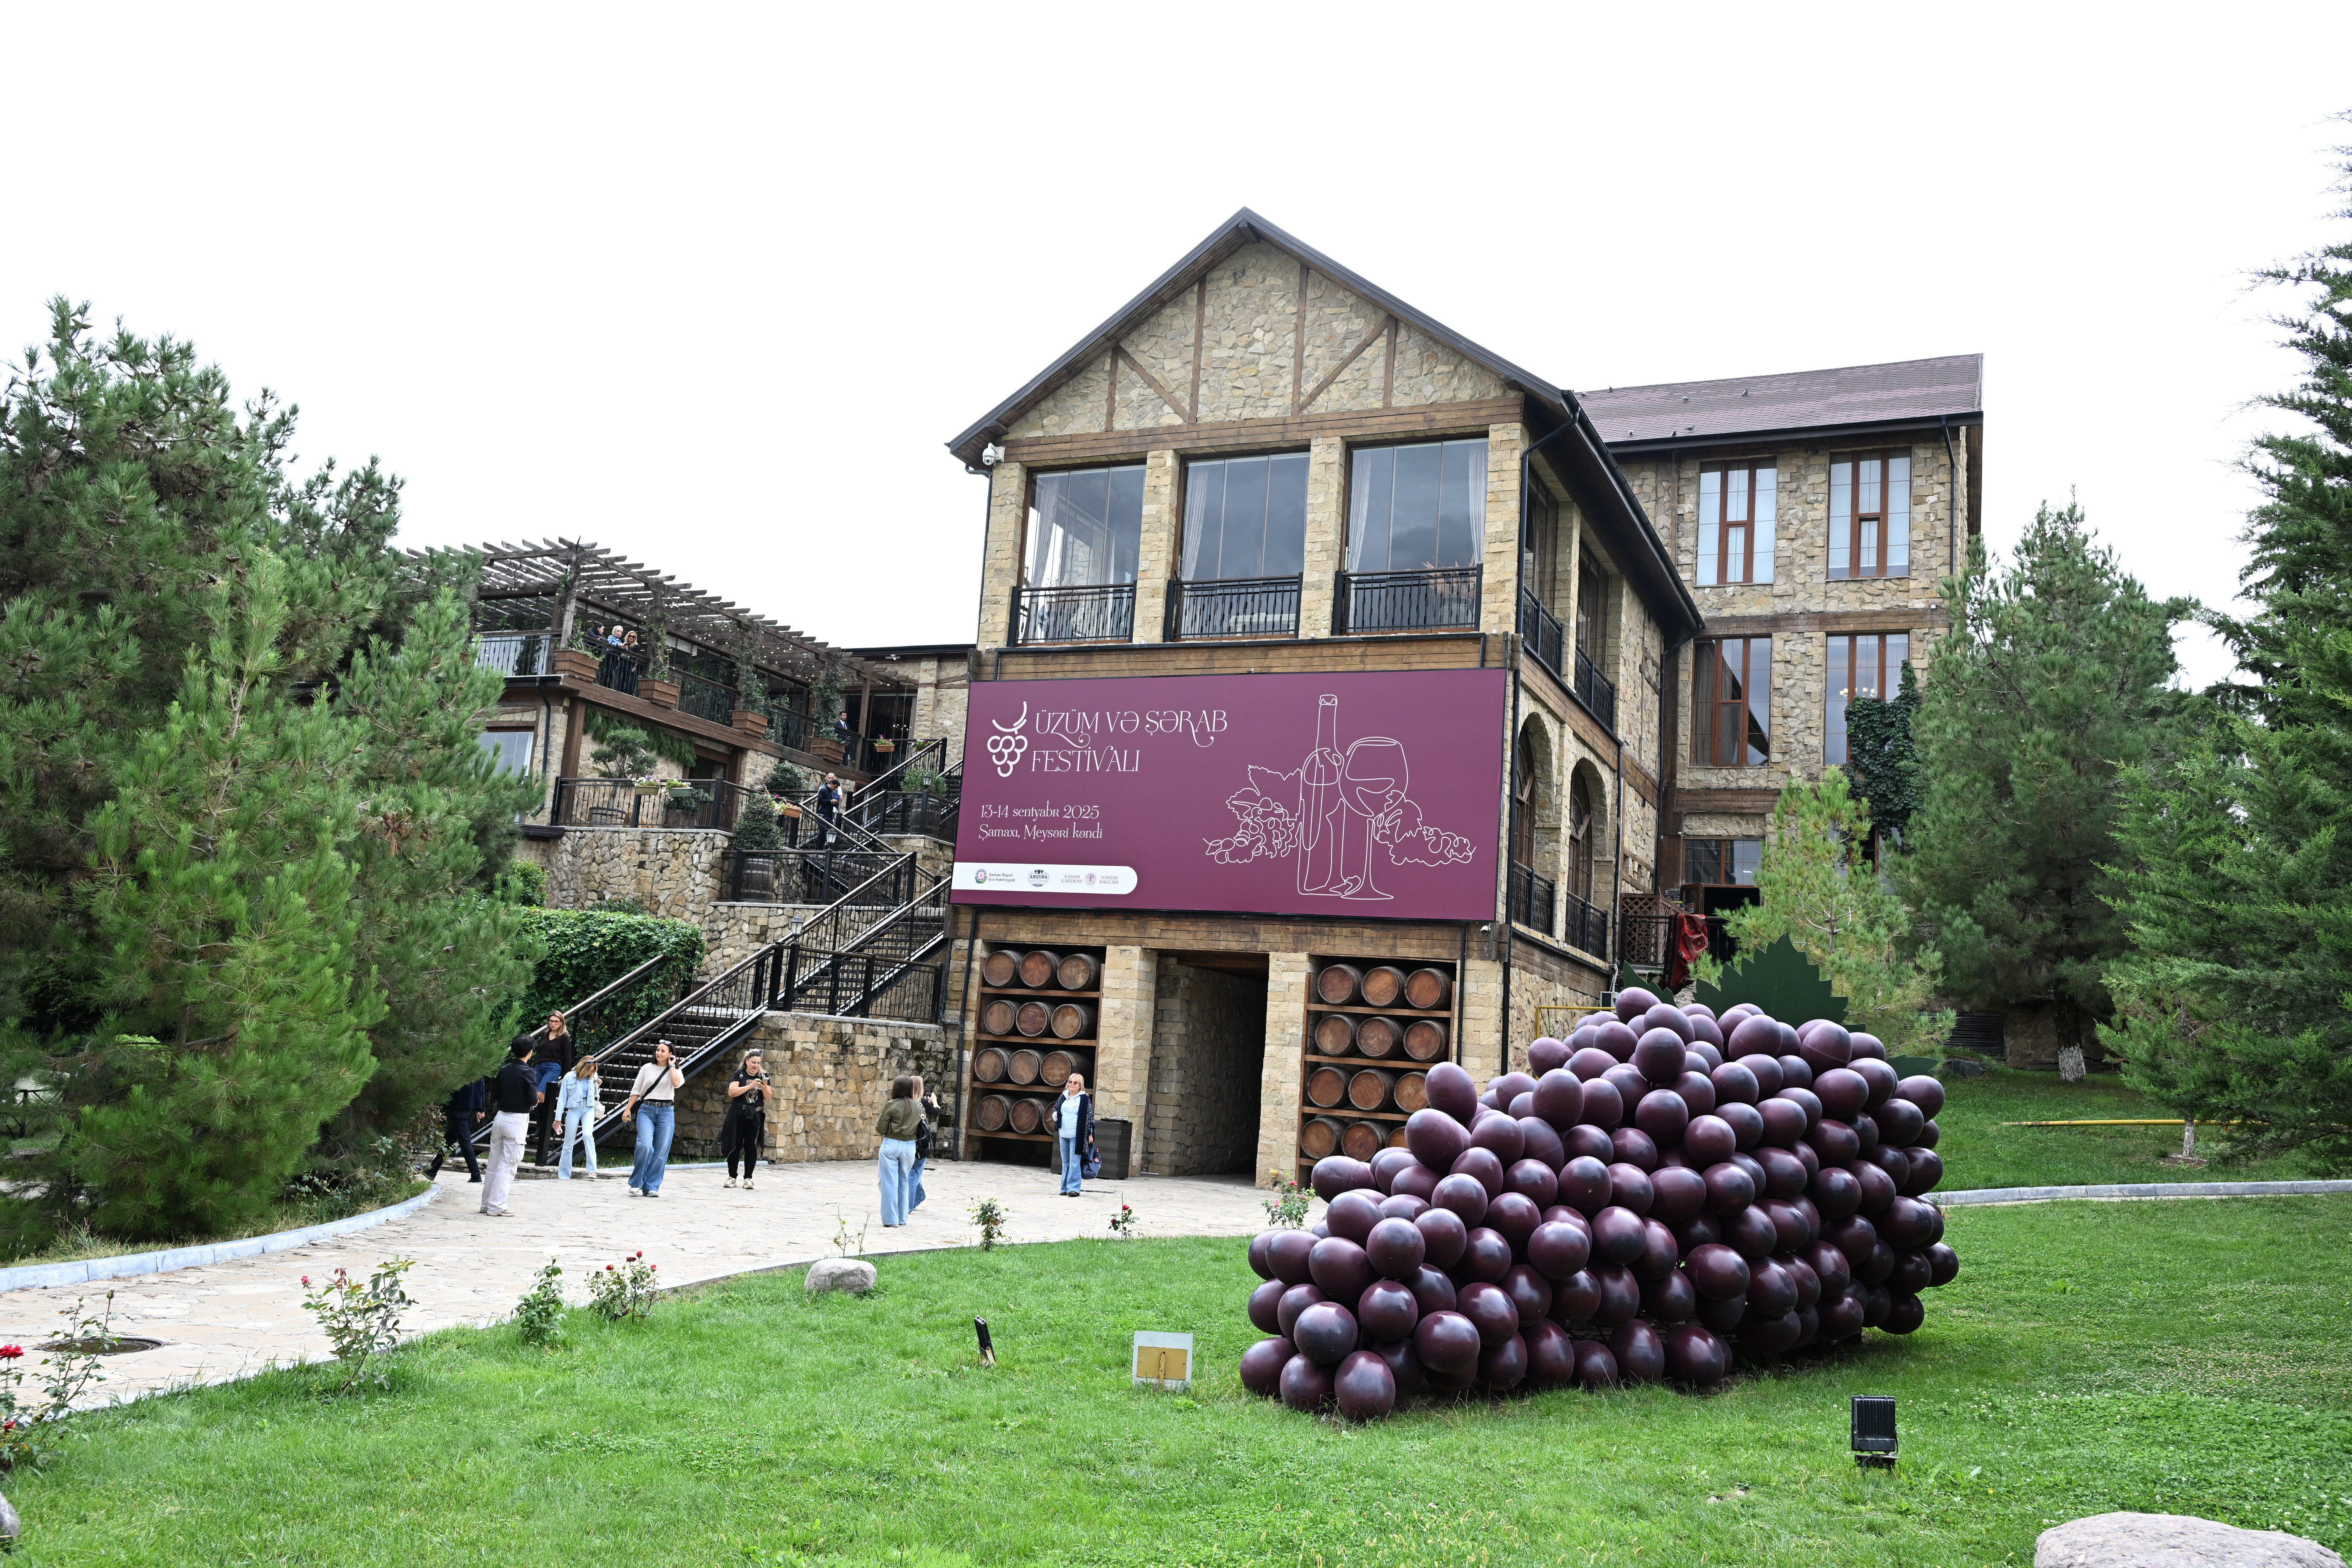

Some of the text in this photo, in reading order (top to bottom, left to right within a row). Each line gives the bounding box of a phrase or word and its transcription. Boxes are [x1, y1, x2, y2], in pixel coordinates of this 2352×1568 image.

[1036, 709, 1227, 748] ÜZÜM VƏ ŞƏRAB
[981, 804, 1009, 818] 13-14
[1063, 805, 1100, 819] 2025
[979, 822, 1103, 842] Şamaxı, Meysəri kəndi
